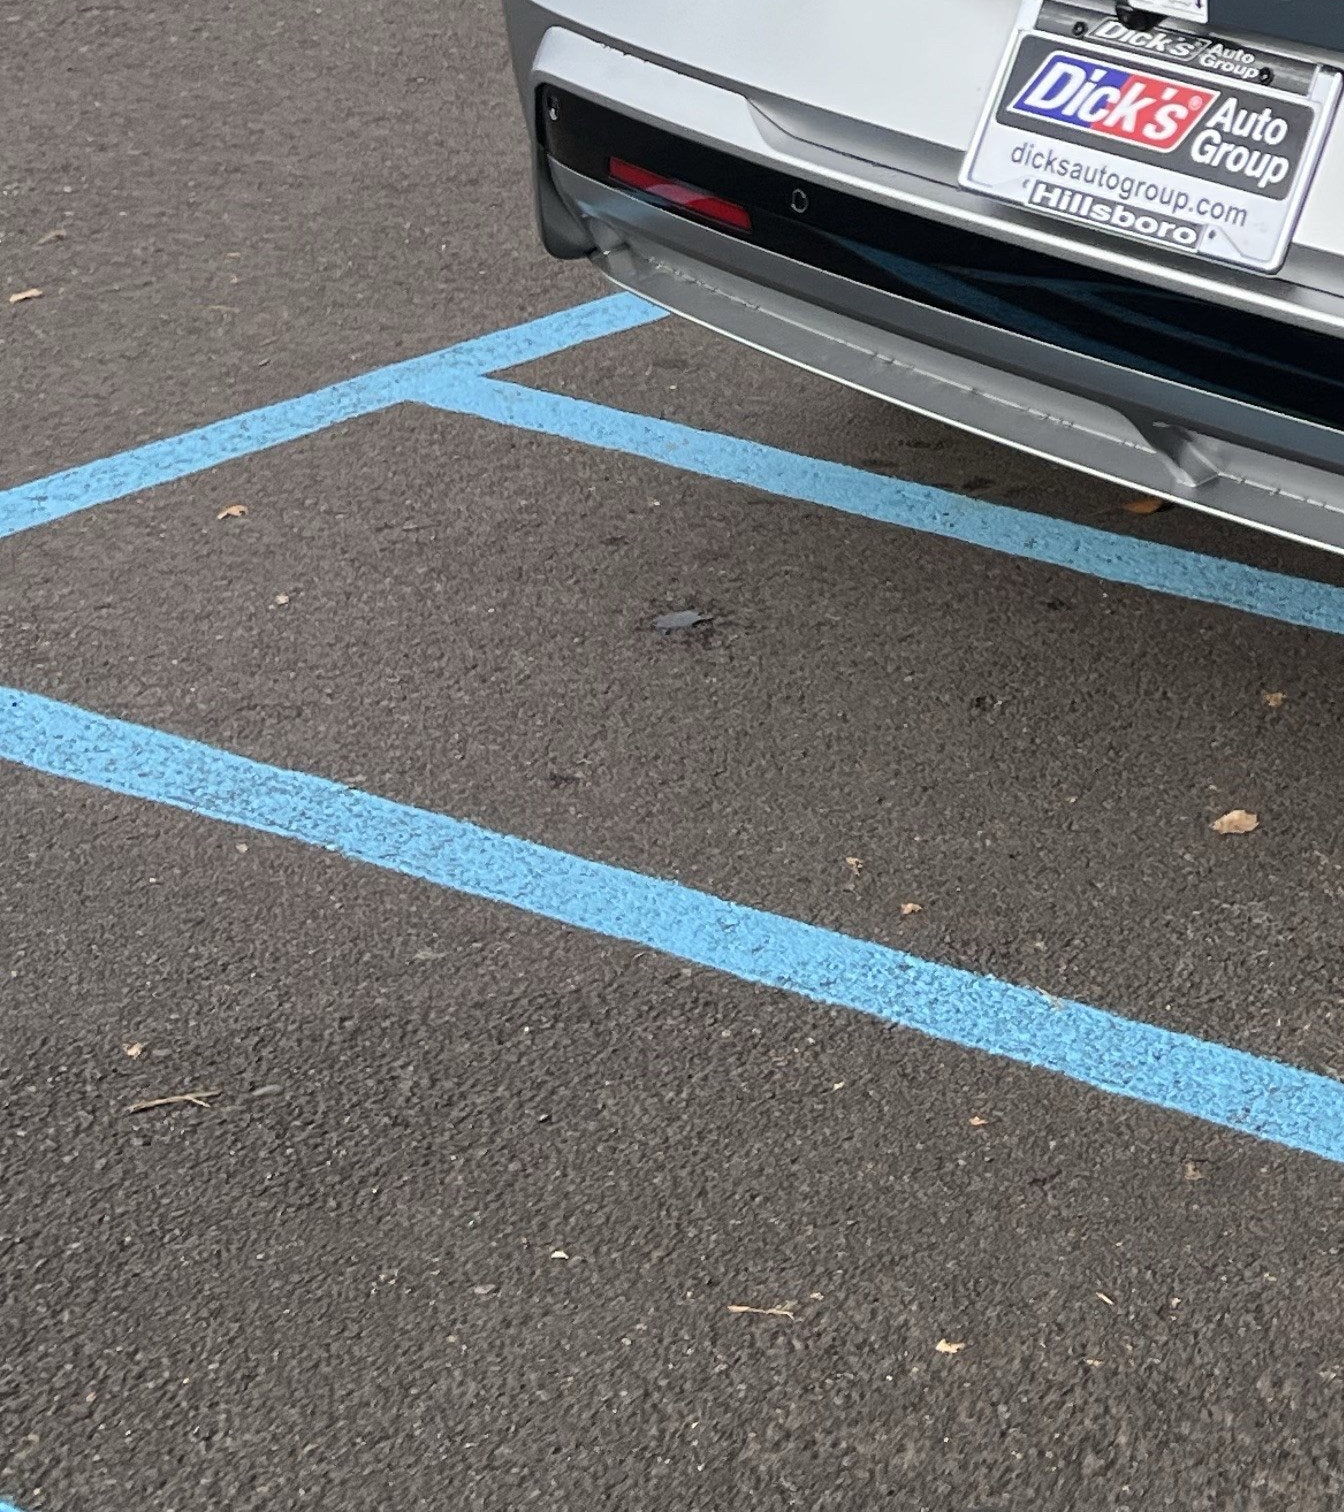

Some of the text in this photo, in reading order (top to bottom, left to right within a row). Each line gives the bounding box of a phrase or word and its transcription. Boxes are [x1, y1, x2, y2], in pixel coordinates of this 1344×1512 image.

[1095, 20, 1255, 64] Dick's Auto
[1200, 53, 1259, 79] Group
[1024, 62, 1288, 145] Dick's Auto
[1011, 143, 1247, 227] dicksautogroup.com
[1191, 129, 1289, 188] Group
[1034, 180, 1198, 246] Hillsboro
